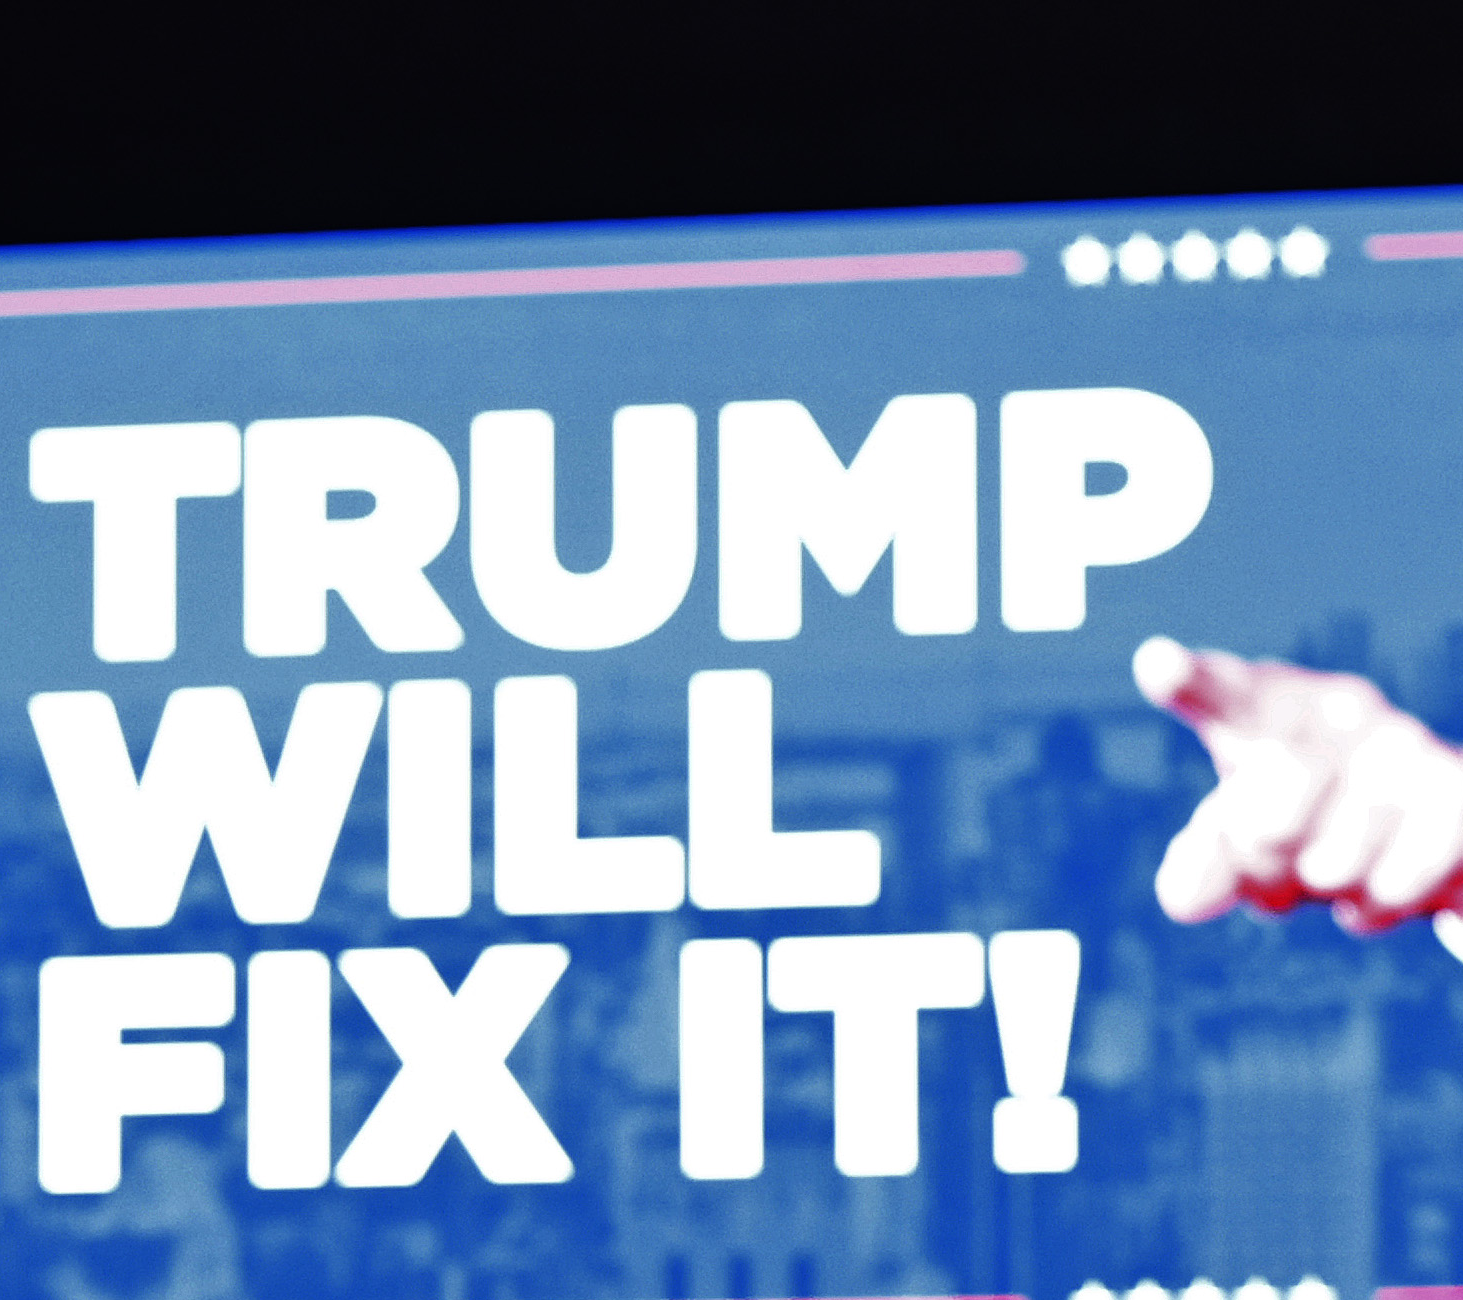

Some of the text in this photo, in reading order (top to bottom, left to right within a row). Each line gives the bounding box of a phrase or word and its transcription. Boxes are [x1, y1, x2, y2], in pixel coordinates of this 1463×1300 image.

[28, 386, 1214, 664] TRUMP
[28, 668, 883, 929] WILL
[37, 929, 1081, 1195] FIX IT!
